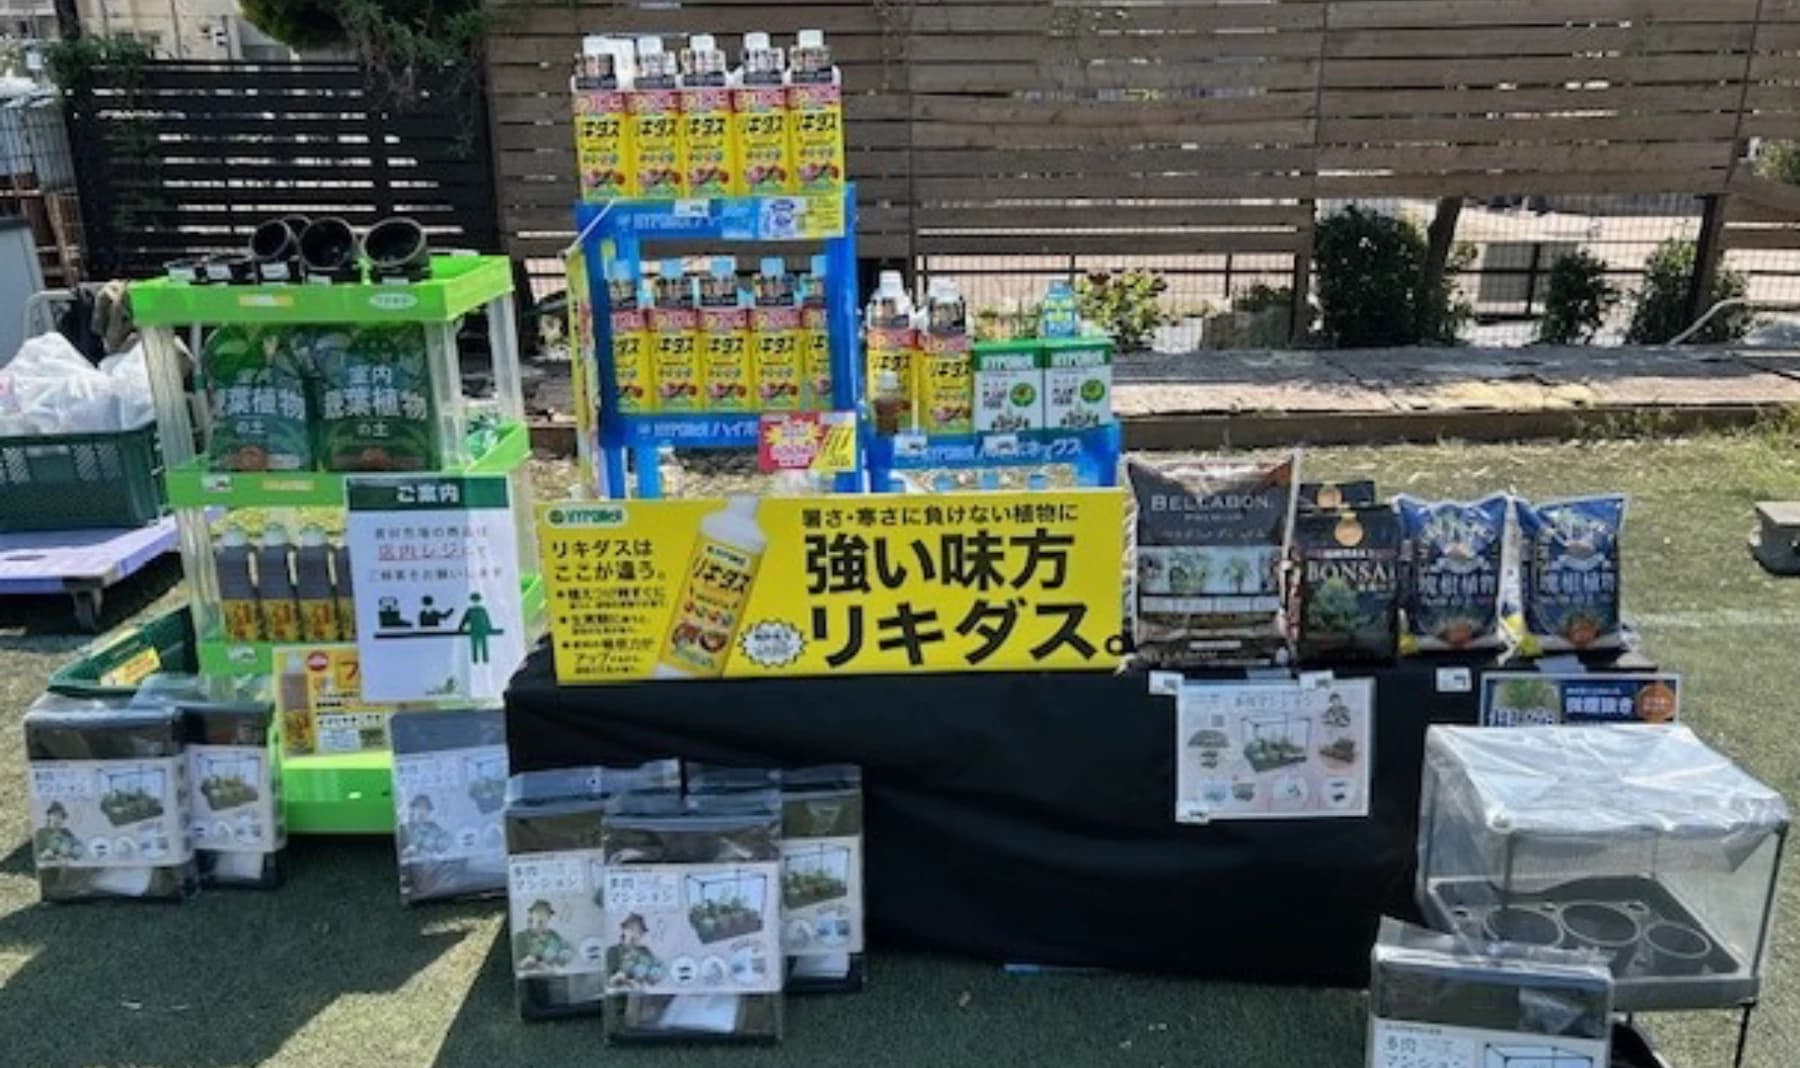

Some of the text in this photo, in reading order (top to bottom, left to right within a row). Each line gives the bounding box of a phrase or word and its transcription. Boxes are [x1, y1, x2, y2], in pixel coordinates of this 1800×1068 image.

[347, 364, 393, 384] 室内
[216, 386, 306, 421] 葉植物
[397, 483, 460, 503] ご案内
[1151, 494, 1269, 513] BELLABON
[802, 503, 1079, 529] 暑さ・寒さに負けない植物に
[552, 539, 653, 558] リキダスは
[555, 561, 666, 582] ここが違う。
[804, 528, 1075, 595] 強い味方
[1307, 559, 1396, 583] BONSAI
[811, 596, 1132, 668] リキダス。
